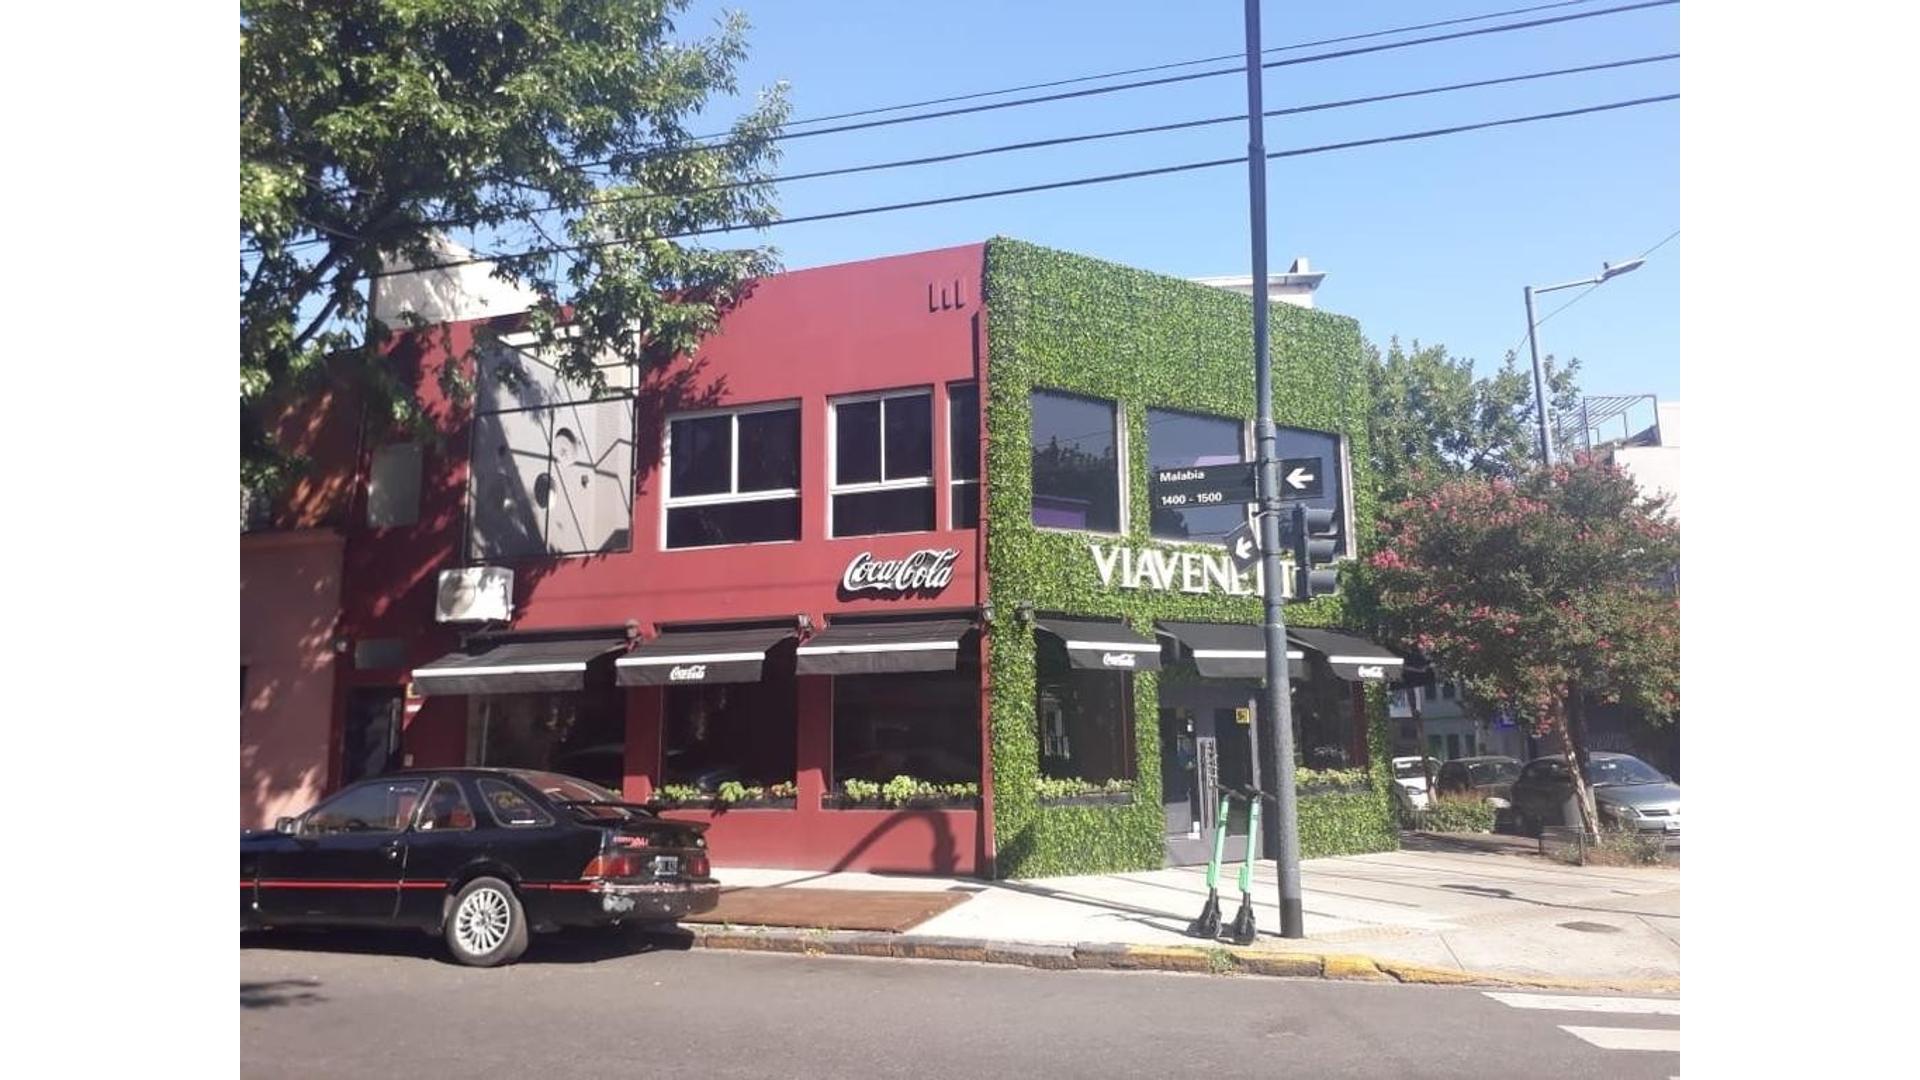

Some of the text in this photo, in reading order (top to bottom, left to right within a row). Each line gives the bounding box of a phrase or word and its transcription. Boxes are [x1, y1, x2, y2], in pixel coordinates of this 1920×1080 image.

[1159, 469, 1205, 482] Malabia
[1161, 494, 1187, 506] 1400
[1196, 492, 1222, 503] 1500
